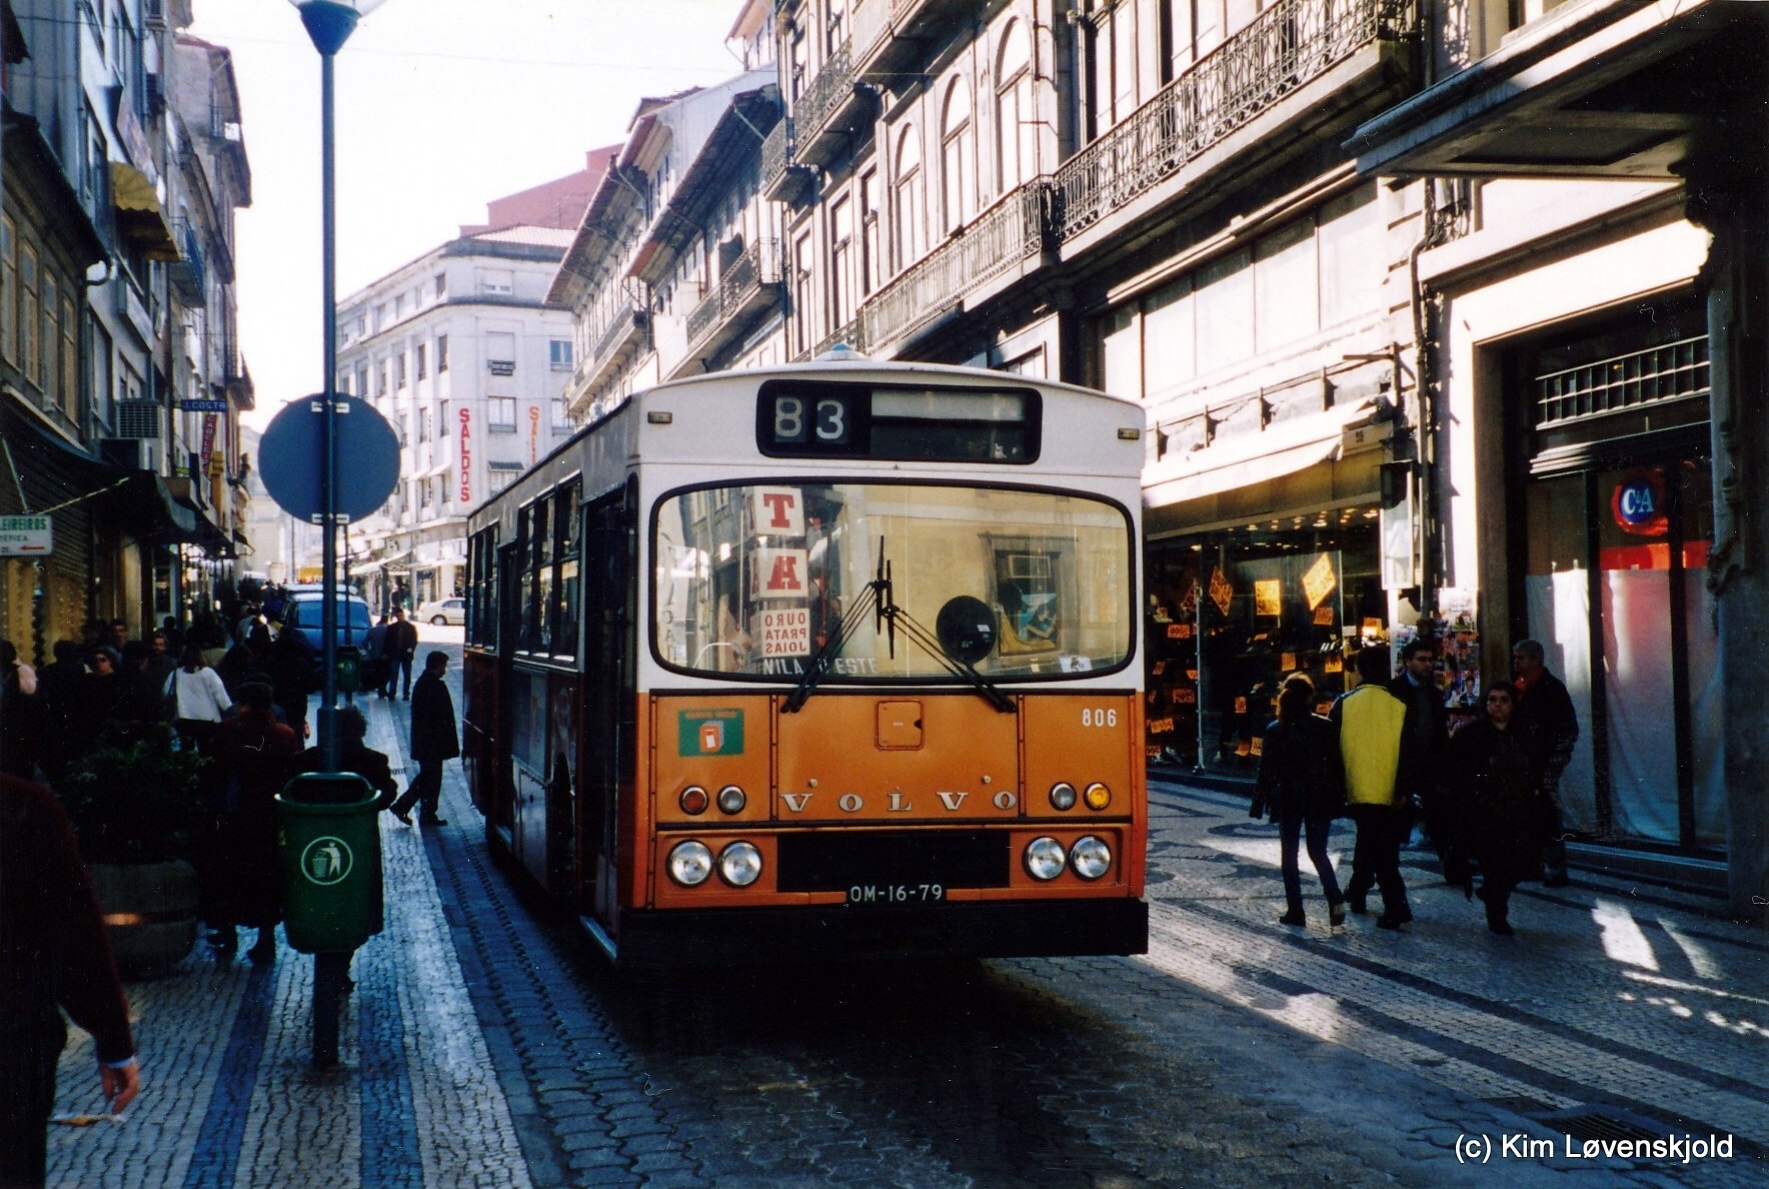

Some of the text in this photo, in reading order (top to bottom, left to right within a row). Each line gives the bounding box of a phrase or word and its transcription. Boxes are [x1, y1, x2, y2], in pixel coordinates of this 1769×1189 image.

[191, 401, 226, 410] COSTA
[774, 396, 844, 440] 83
[459, 407, 471, 503] SALDOS
[1621, 488, 1655, 515] C&A
[1082, 708, 1117, 727] 806
[780, 791, 1018, 812] VOLVO
[850, 884, 943, 902] OM-16-79
